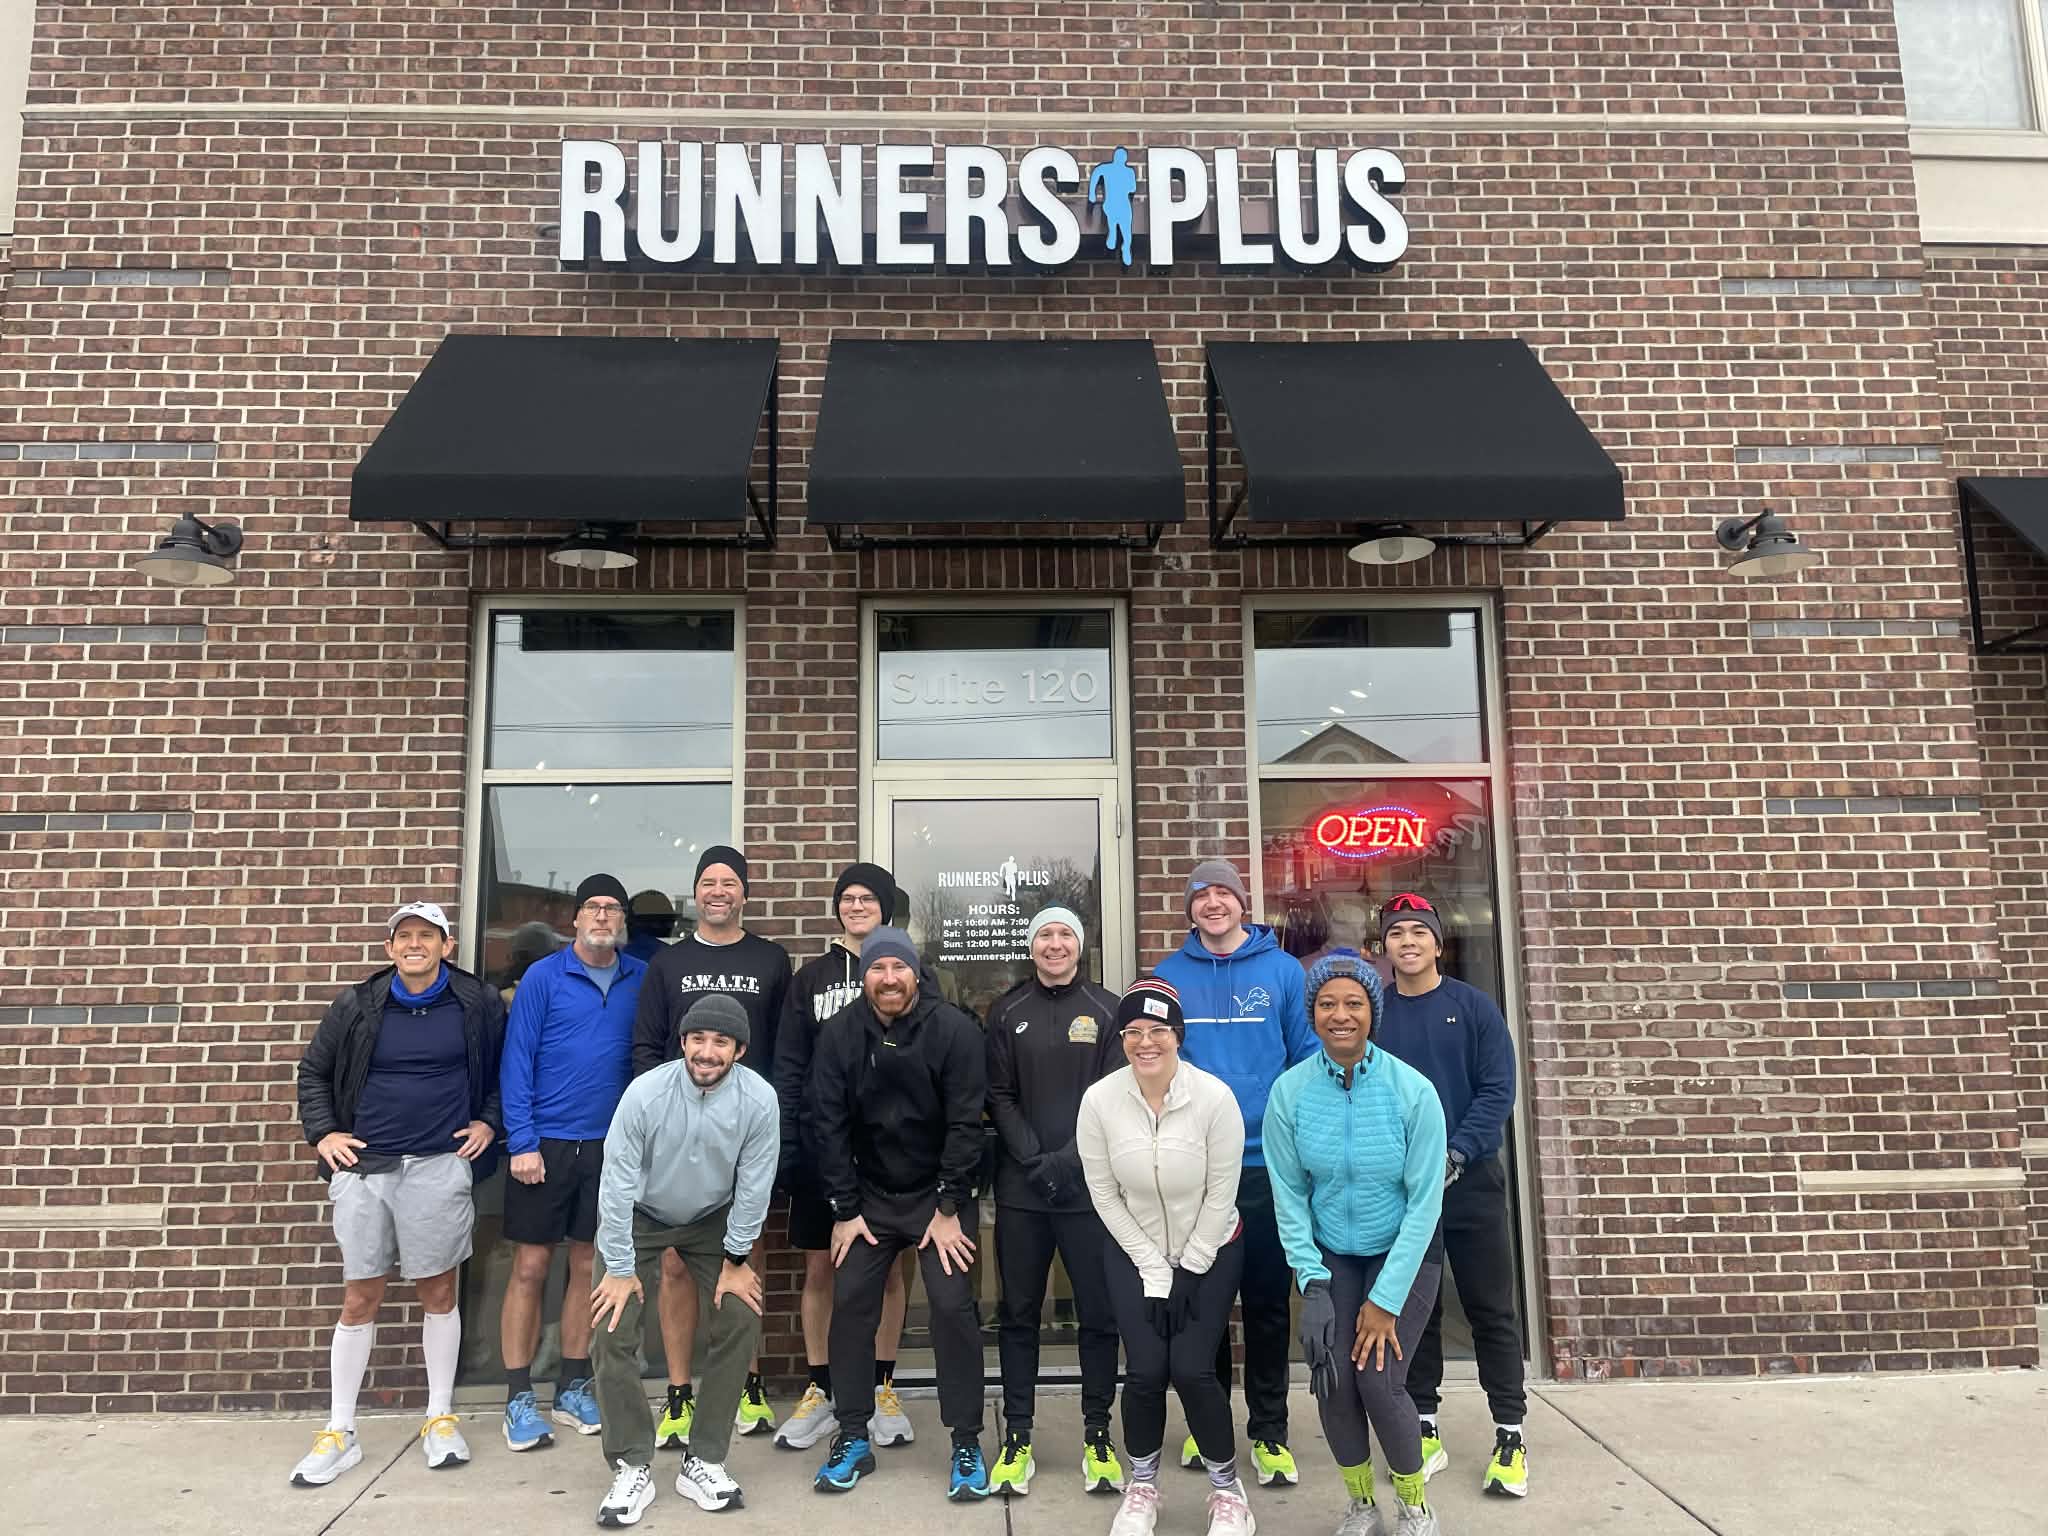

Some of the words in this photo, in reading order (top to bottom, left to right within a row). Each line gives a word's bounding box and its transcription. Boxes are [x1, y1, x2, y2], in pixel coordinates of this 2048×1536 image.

[560, 140, 1080, 267] RUNNERS
[1148, 146, 1409, 265] PLUS
[891, 670, 1007, 704] Suite
[1021, 668, 1099, 704] 120
[1316, 813, 1428, 848] OPEN
[938, 871, 1000, 888] RUNNERS
[1017, 870, 1050, 886] PLUS
[968, 903, 1021, 915] HOURS:
[965, 918, 989, 926] 10:00
[1010, 917, 1030, 926] 7:00
[943, 929, 961, 938] Sat:
[966, 929, 990, 937] 10:00
[943, 940, 964, 949] Sun:
[966, 940, 990, 948] 12:00
[681, 974, 760, 990] S.W.A.T.T.
